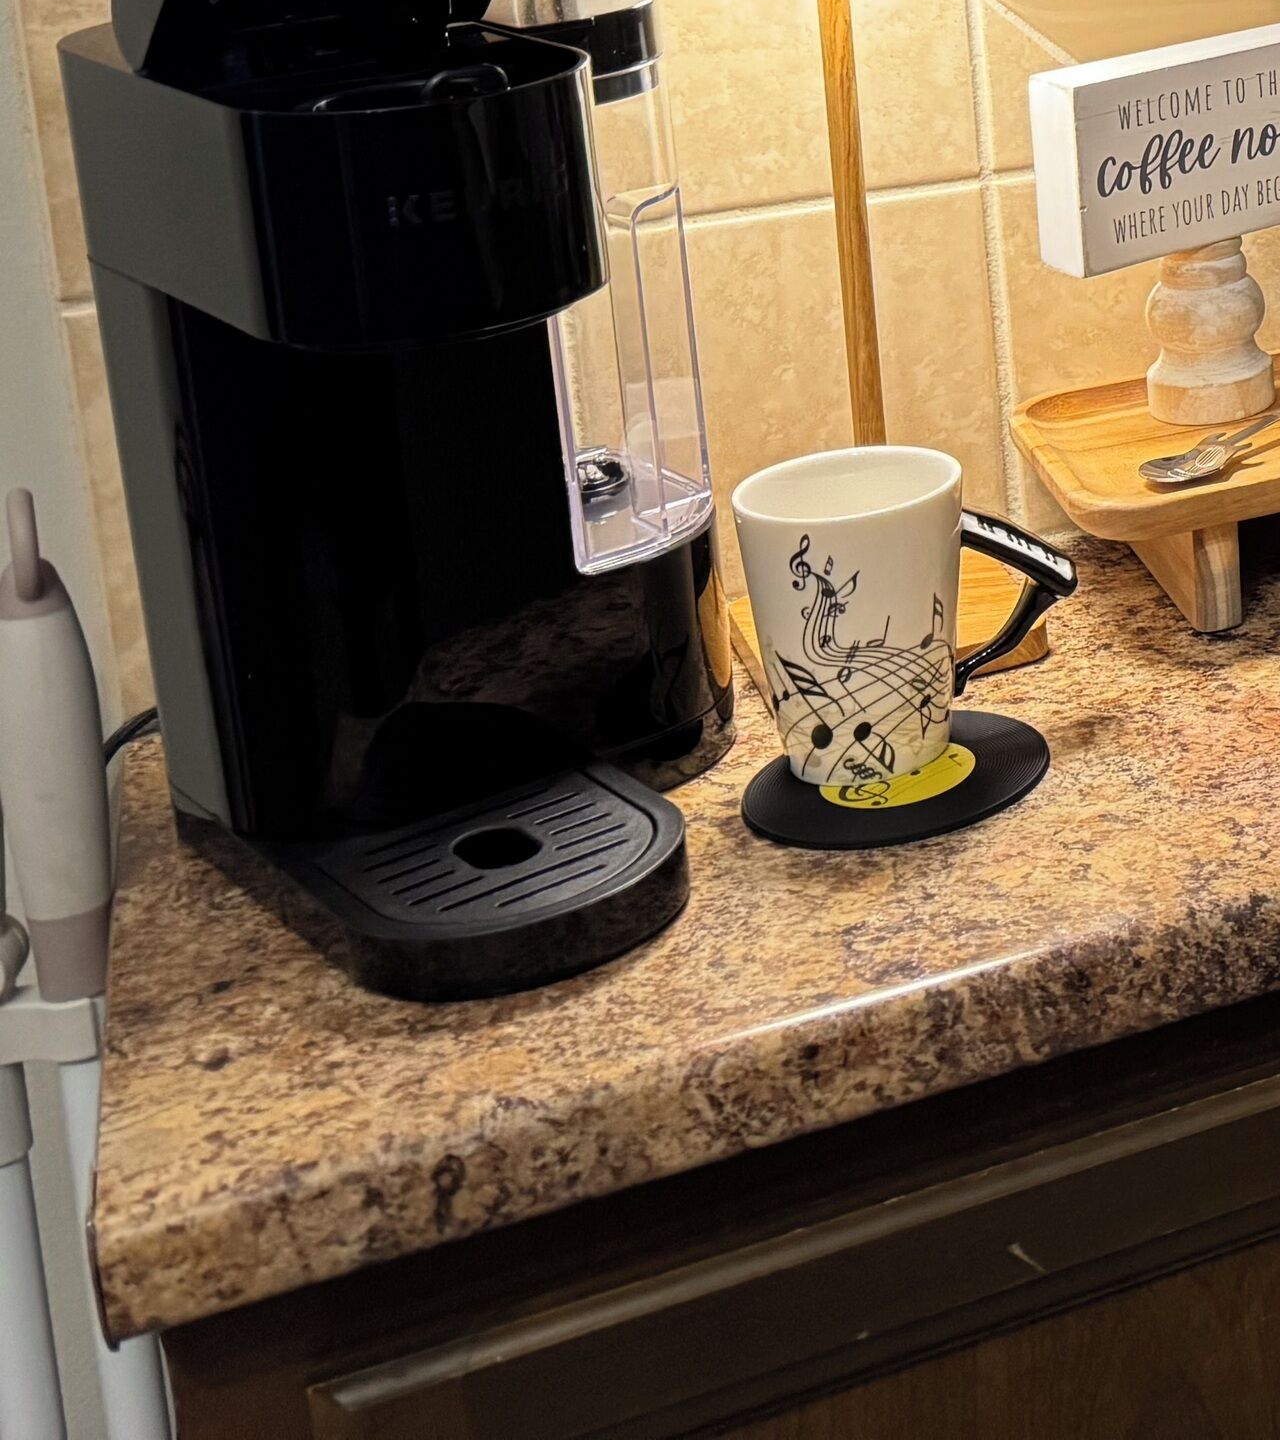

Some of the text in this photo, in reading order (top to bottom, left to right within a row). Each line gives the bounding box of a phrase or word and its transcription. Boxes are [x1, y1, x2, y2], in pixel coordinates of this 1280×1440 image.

[1117, 84, 1213, 131] WELCOME
[1223, 75, 1247, 105] TO
[1096, 129, 1221, 198] coffee
[1113, 205, 1166, 244] WHERE
[1172, 194, 1215, 229] YOUR
[1221, 184, 1250, 216] DAY
